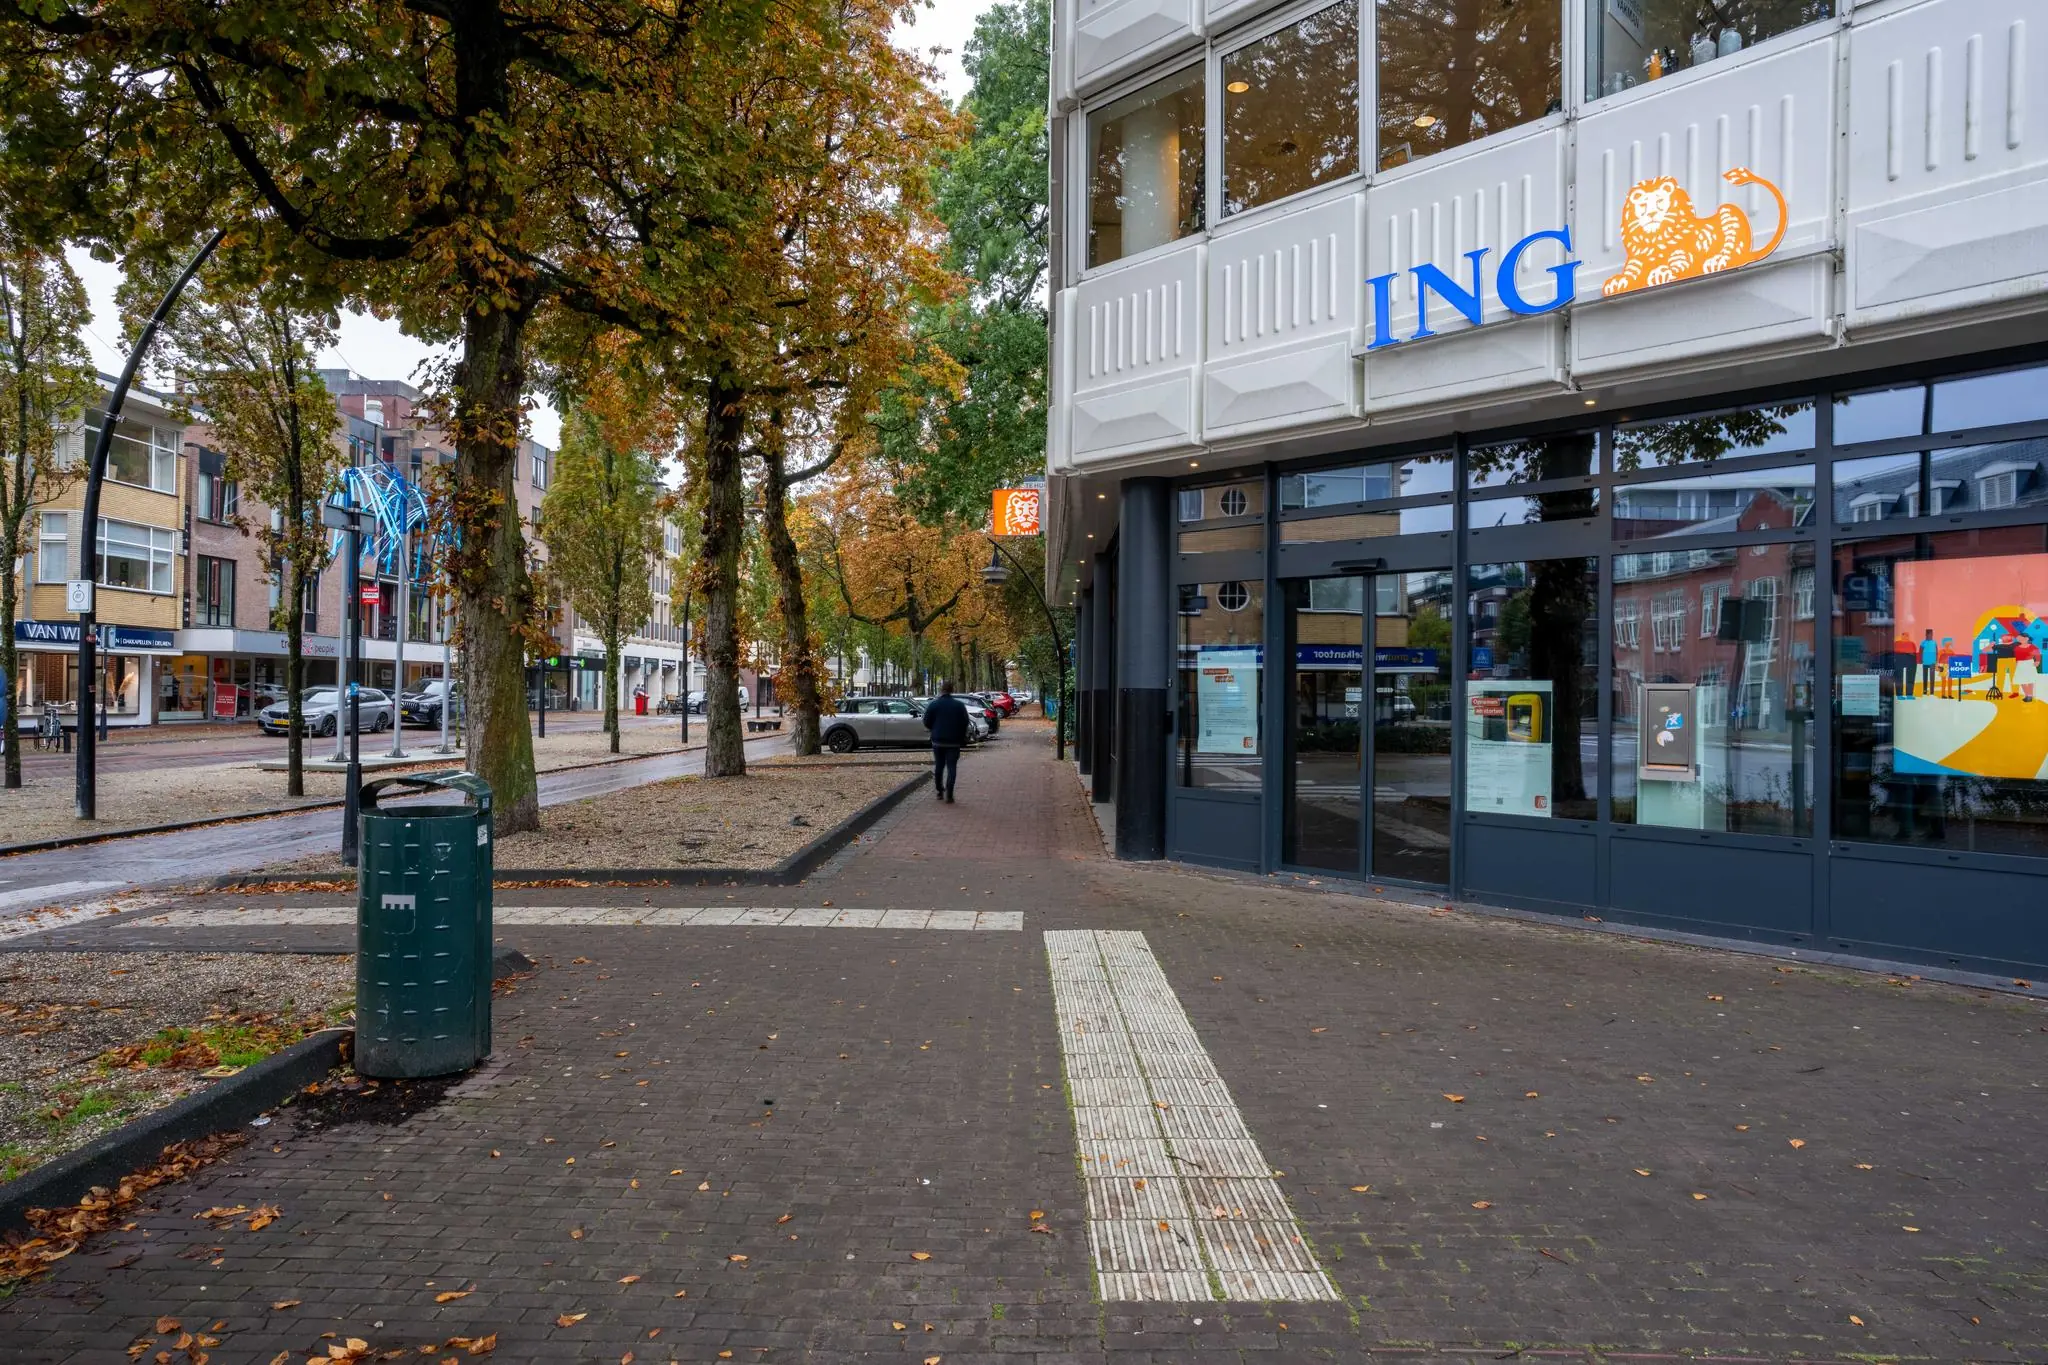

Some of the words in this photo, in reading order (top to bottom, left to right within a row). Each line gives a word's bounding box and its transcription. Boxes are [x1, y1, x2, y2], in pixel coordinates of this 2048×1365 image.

[1364, 224, 1583, 350] ING
[24, 623, 58, 639] VAN
[314, 643, 336, 655] people
